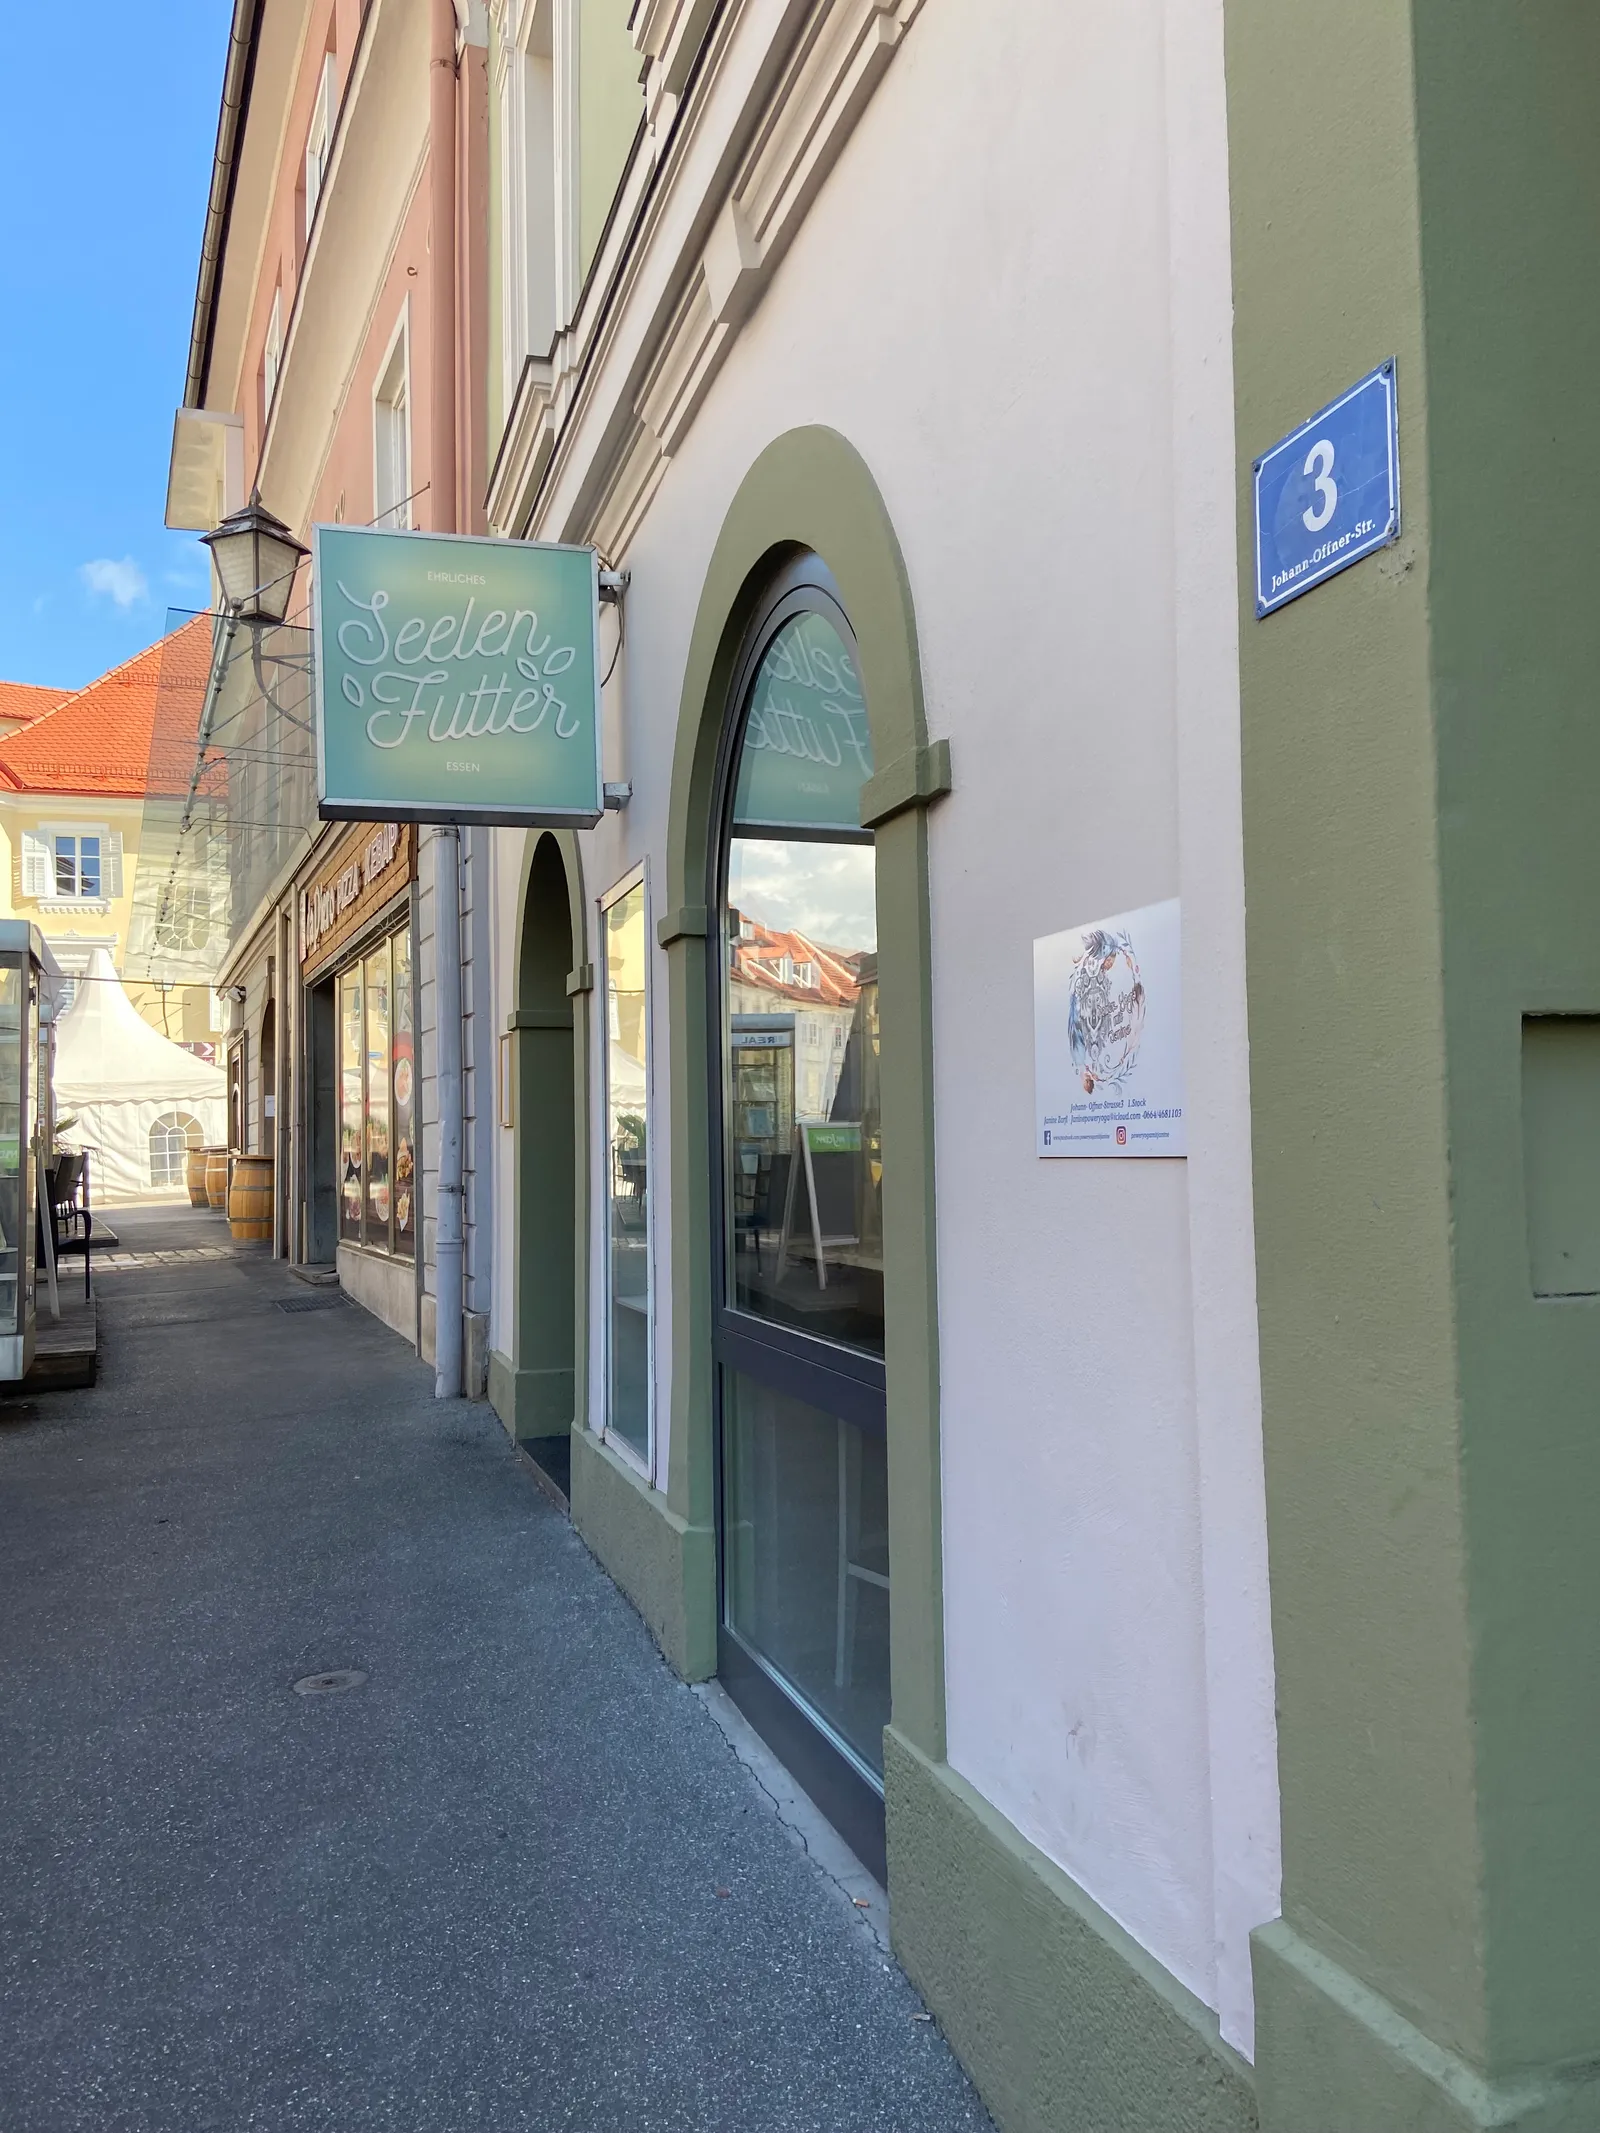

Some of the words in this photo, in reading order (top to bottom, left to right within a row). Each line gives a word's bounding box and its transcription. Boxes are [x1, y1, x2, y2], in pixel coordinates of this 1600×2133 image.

[1302, 439, 1338, 532] 3
[427, 570, 486, 585] EHRLICHES
[1271, 519, 1376, 593] Johann-Offner-Str.
[336, 579, 551, 665] Seelen
[366, 670, 581, 749] Futter
[446, 761, 481, 772] ESSEN
[364, 823, 399, 886] KEBAP
